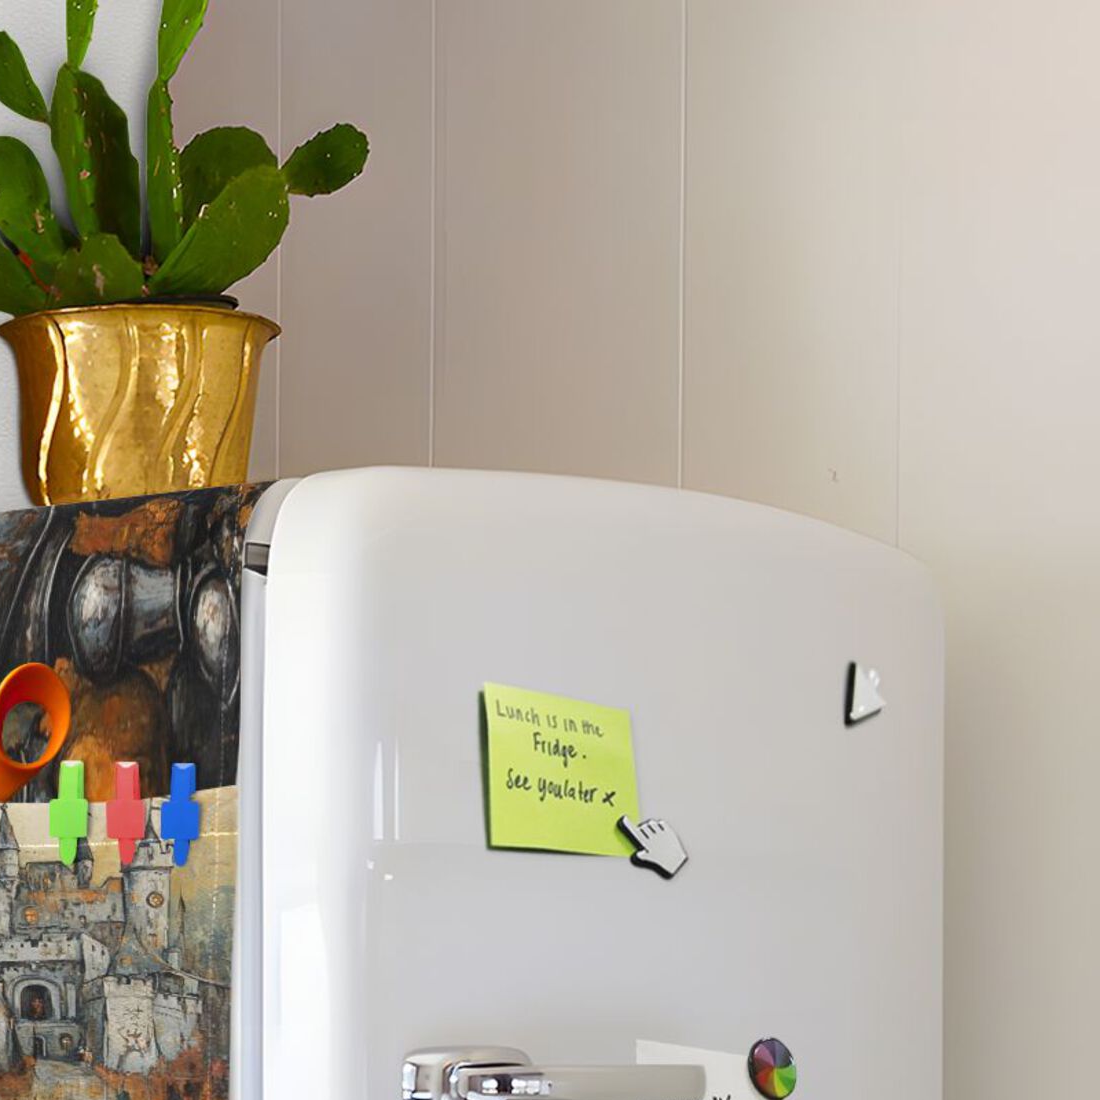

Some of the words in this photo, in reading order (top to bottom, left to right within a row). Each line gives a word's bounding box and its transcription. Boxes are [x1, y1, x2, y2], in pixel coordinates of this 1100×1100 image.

[495, 699, 540, 727] Lunch
[582, 720, 604, 738] the
[506, 768, 532, 791] See
